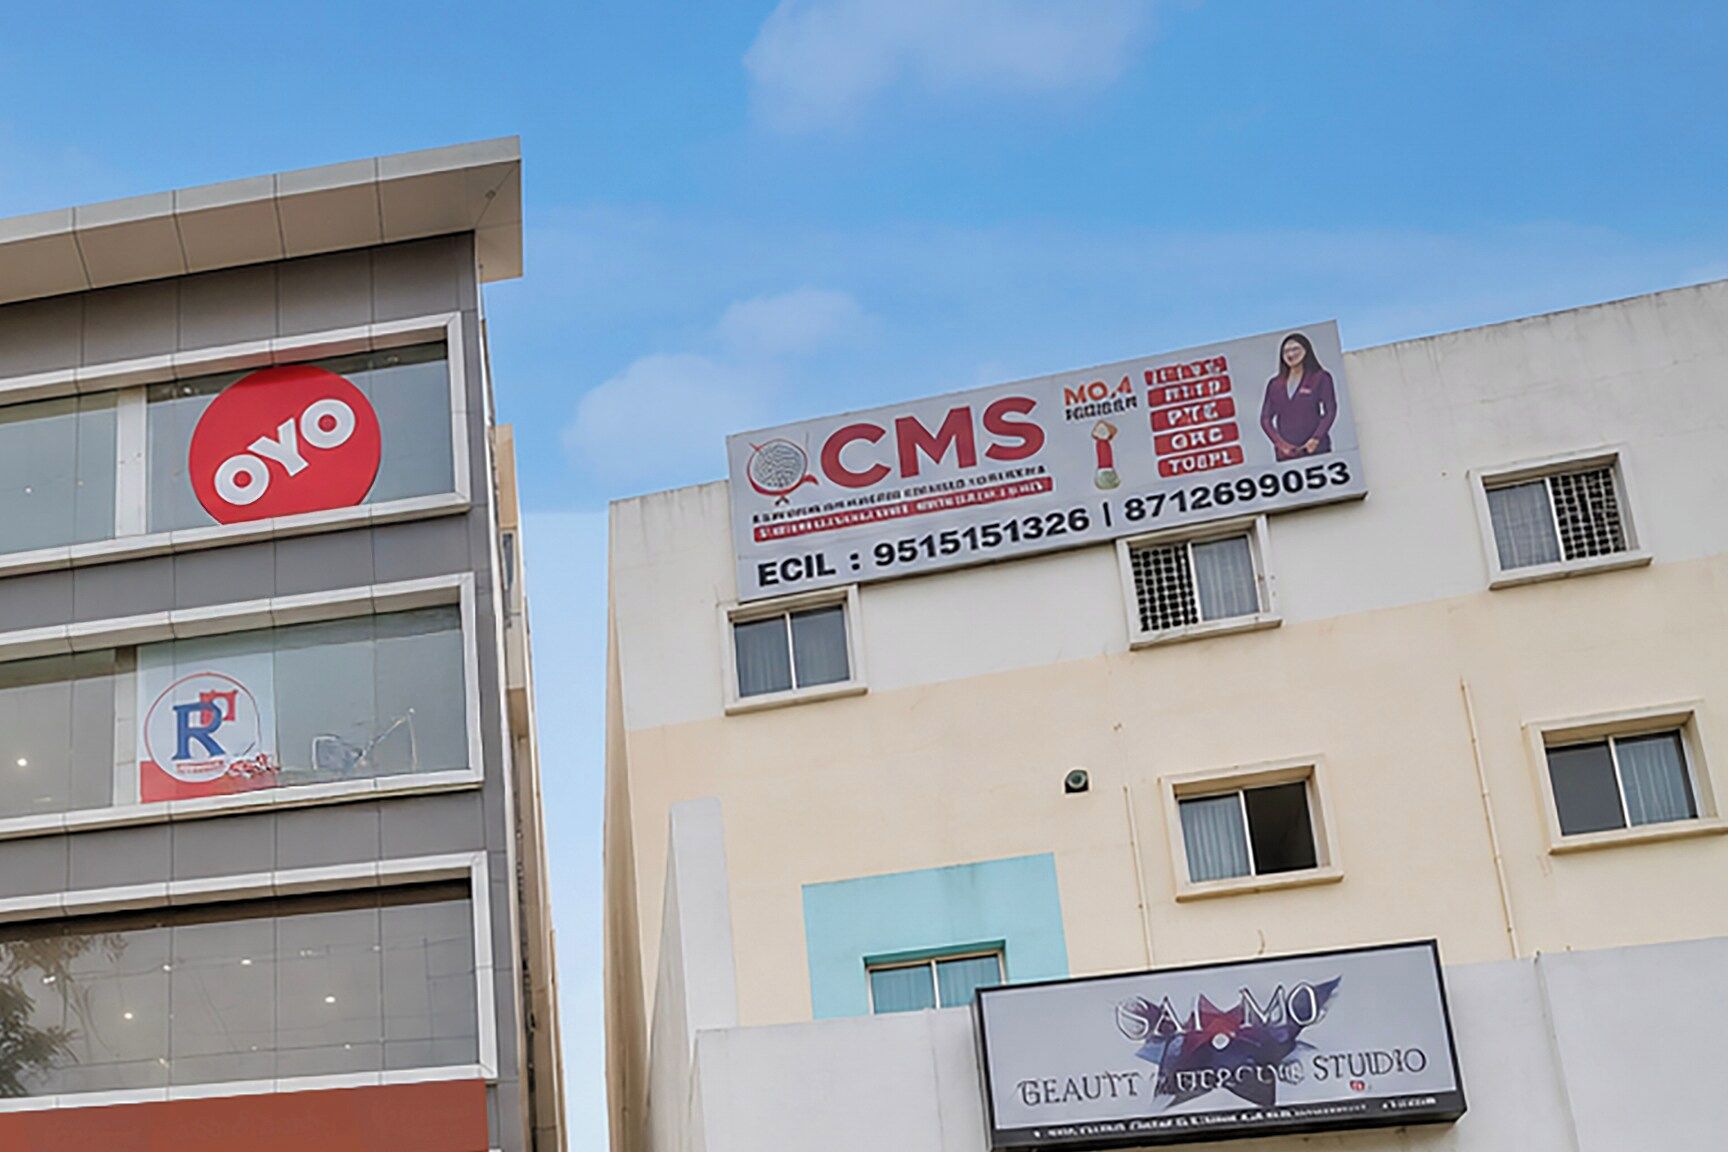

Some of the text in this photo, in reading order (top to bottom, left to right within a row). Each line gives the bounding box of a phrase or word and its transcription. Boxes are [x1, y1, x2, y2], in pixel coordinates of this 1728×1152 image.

[214, 398, 356, 506] OYO
[820, 397, 1047, 489] CMS
[757, 552, 836, 587] ECIL
[874, 507, 1090, 567] 9515151326
[1124, 461, 1351, 521] 8712699053
